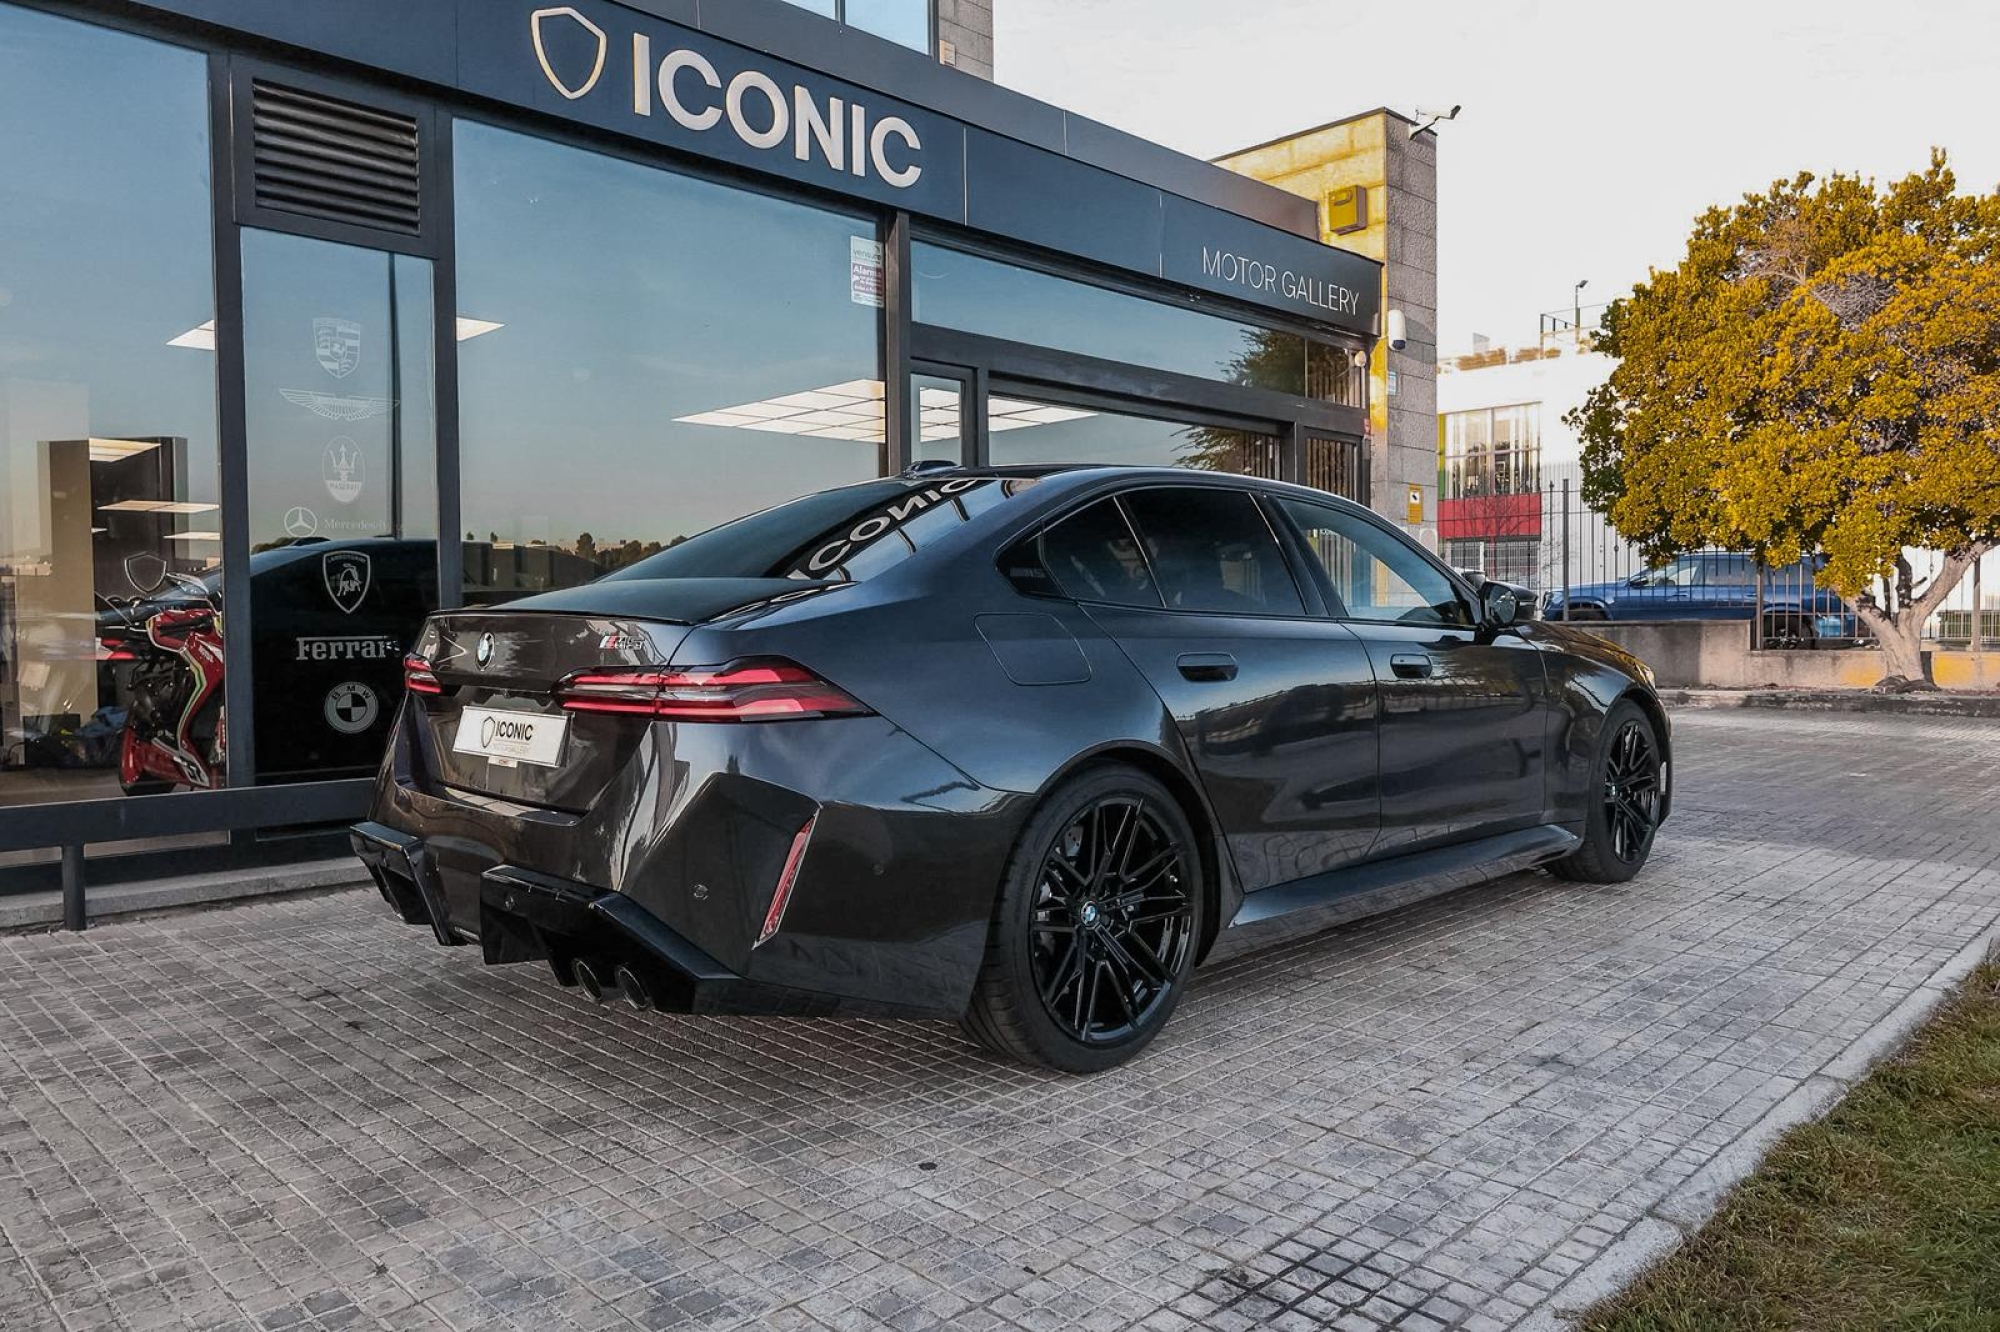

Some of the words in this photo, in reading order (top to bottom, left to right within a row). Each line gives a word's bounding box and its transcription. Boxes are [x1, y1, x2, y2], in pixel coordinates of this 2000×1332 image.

[633, 32, 922, 188] ICONIC
[1203, 246, 1277, 293] MOTOR
[1281, 270, 1360, 316] GALLERY
[331, 685, 371, 701] BMW
[495, 720, 533, 741] ICONIC
